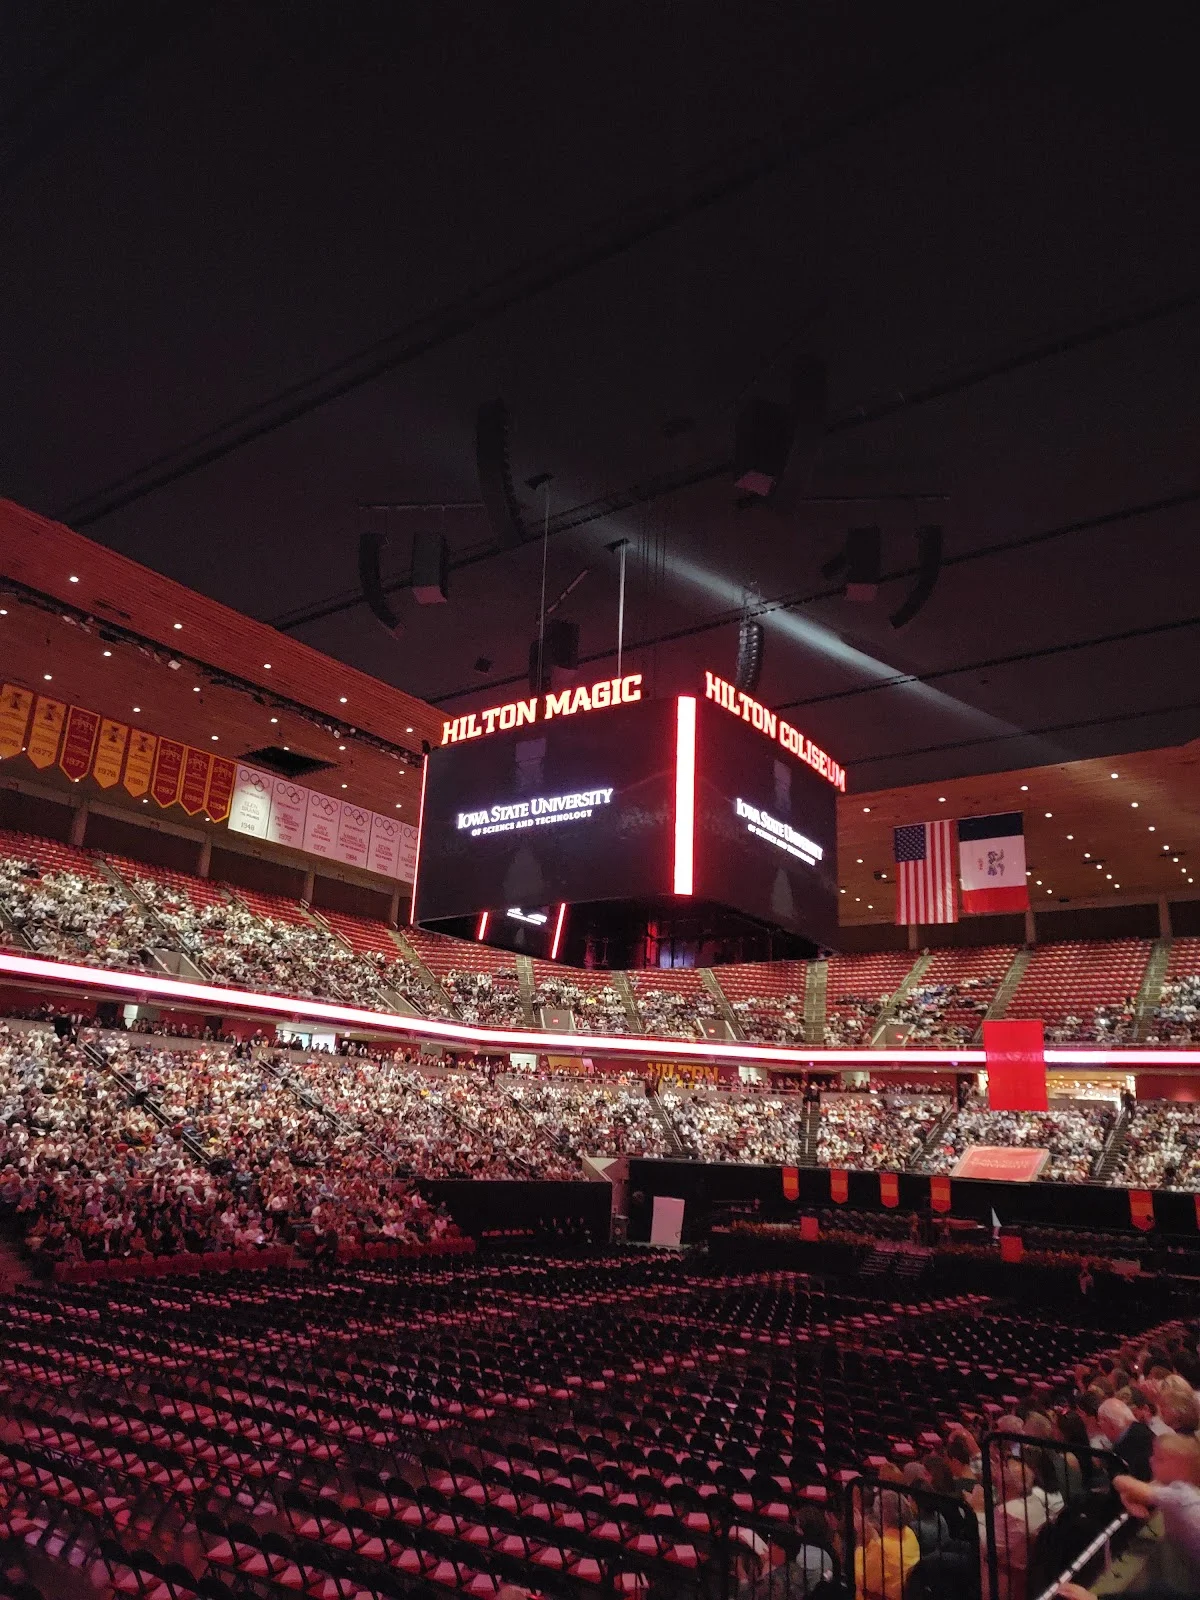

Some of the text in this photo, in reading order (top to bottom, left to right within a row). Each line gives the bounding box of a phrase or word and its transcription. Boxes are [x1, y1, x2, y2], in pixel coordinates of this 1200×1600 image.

[441, 674, 642, 745] HILTON MAGIC
[705, 671, 846, 792] HILTON COLISEUM
[240, 821, 255, 832] 1948
[458, 788, 613, 829] IOWA STATE UNIVERSITY
[482, 821, 515, 835] SCIENCE
[516, 818, 534, 829] AND
[535, 810, 593, 826] TECHNOLOGY
